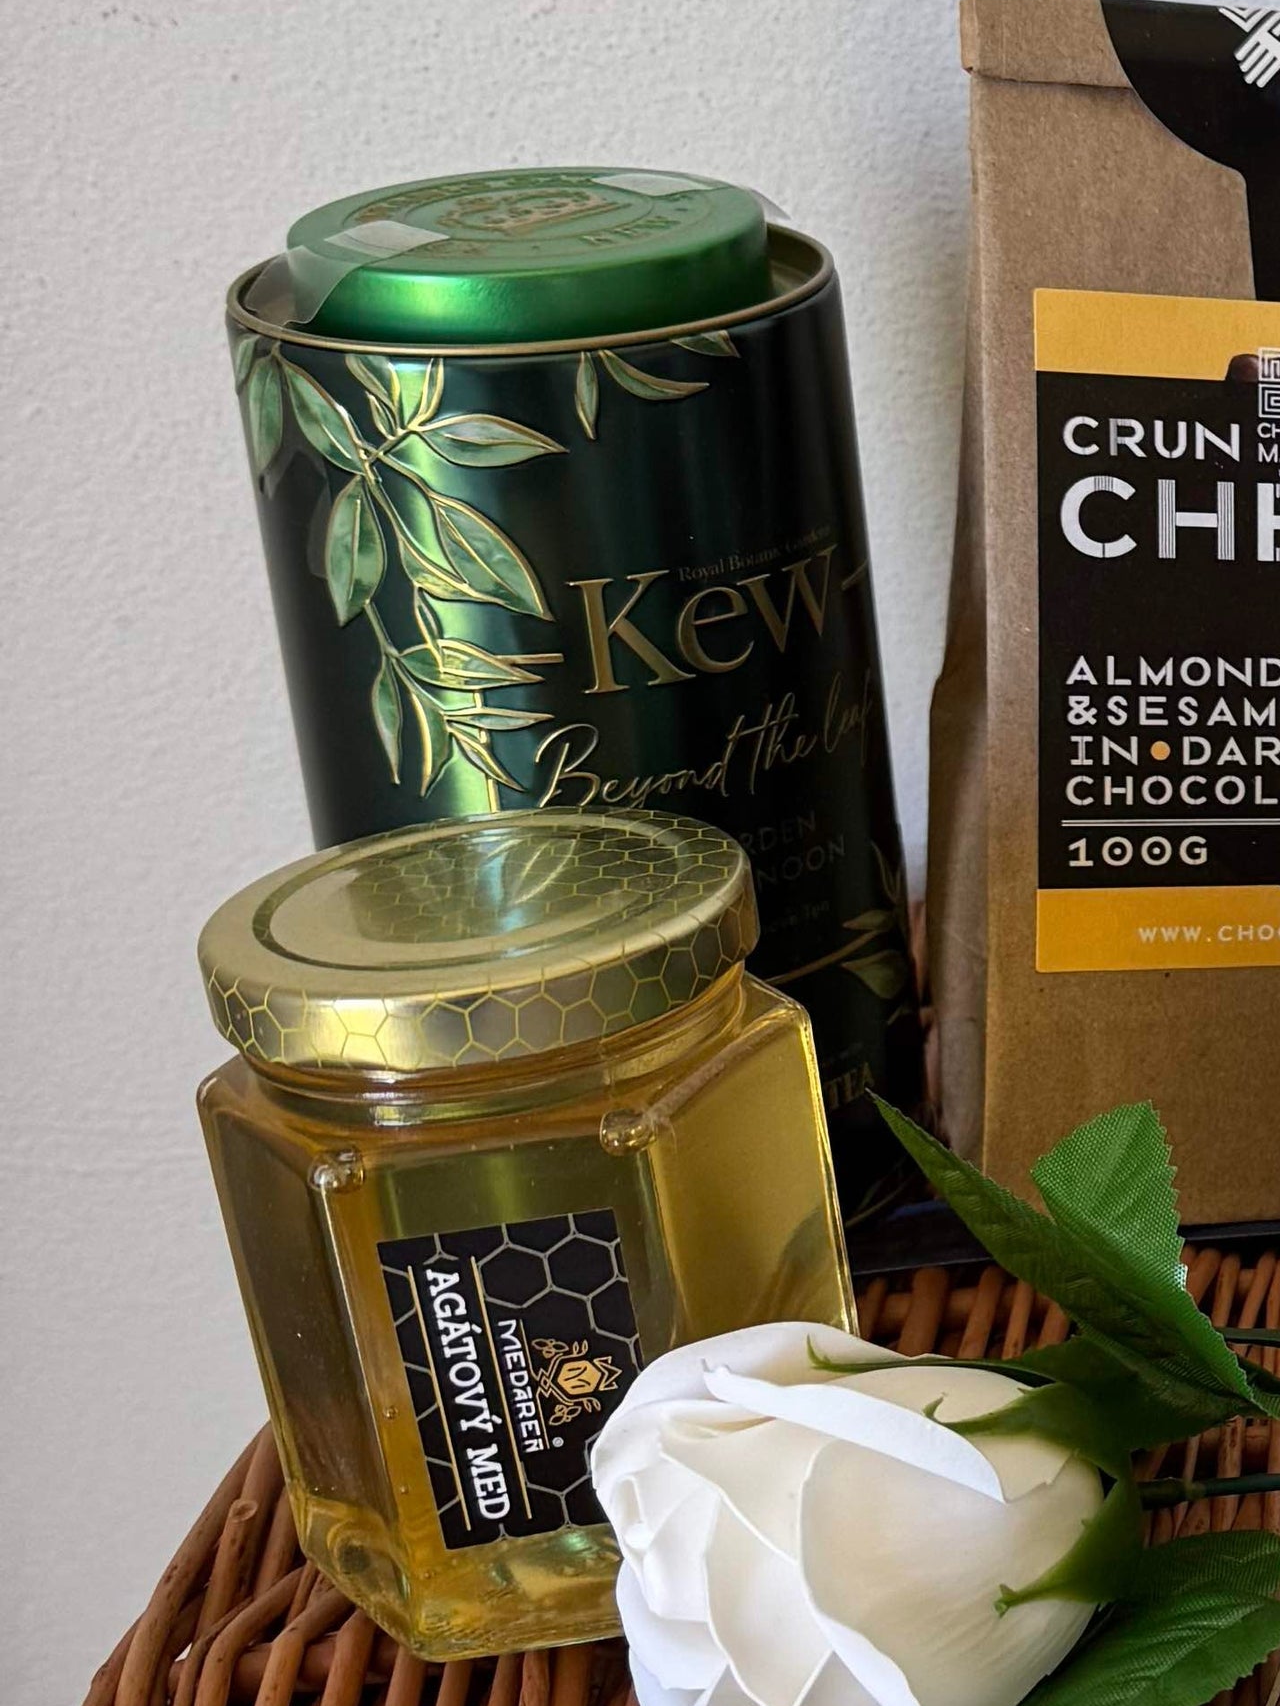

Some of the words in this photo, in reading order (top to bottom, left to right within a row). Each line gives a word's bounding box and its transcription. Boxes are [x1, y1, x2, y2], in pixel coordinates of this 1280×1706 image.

[1062, 415, 1241, 463] CRUN
[677, 558, 726, 584] Royal
[565, 544, 838, 694] Kew
[534, 715, 745, 809] Beyond
[745, 691, 817, 795] the
[1069, 735, 1140, 767] IN
[1067, 835, 1209, 868] 100G
[425, 1267, 504, 1434] AGÁTOVÝ
[465, 1442, 512, 1521] MED
